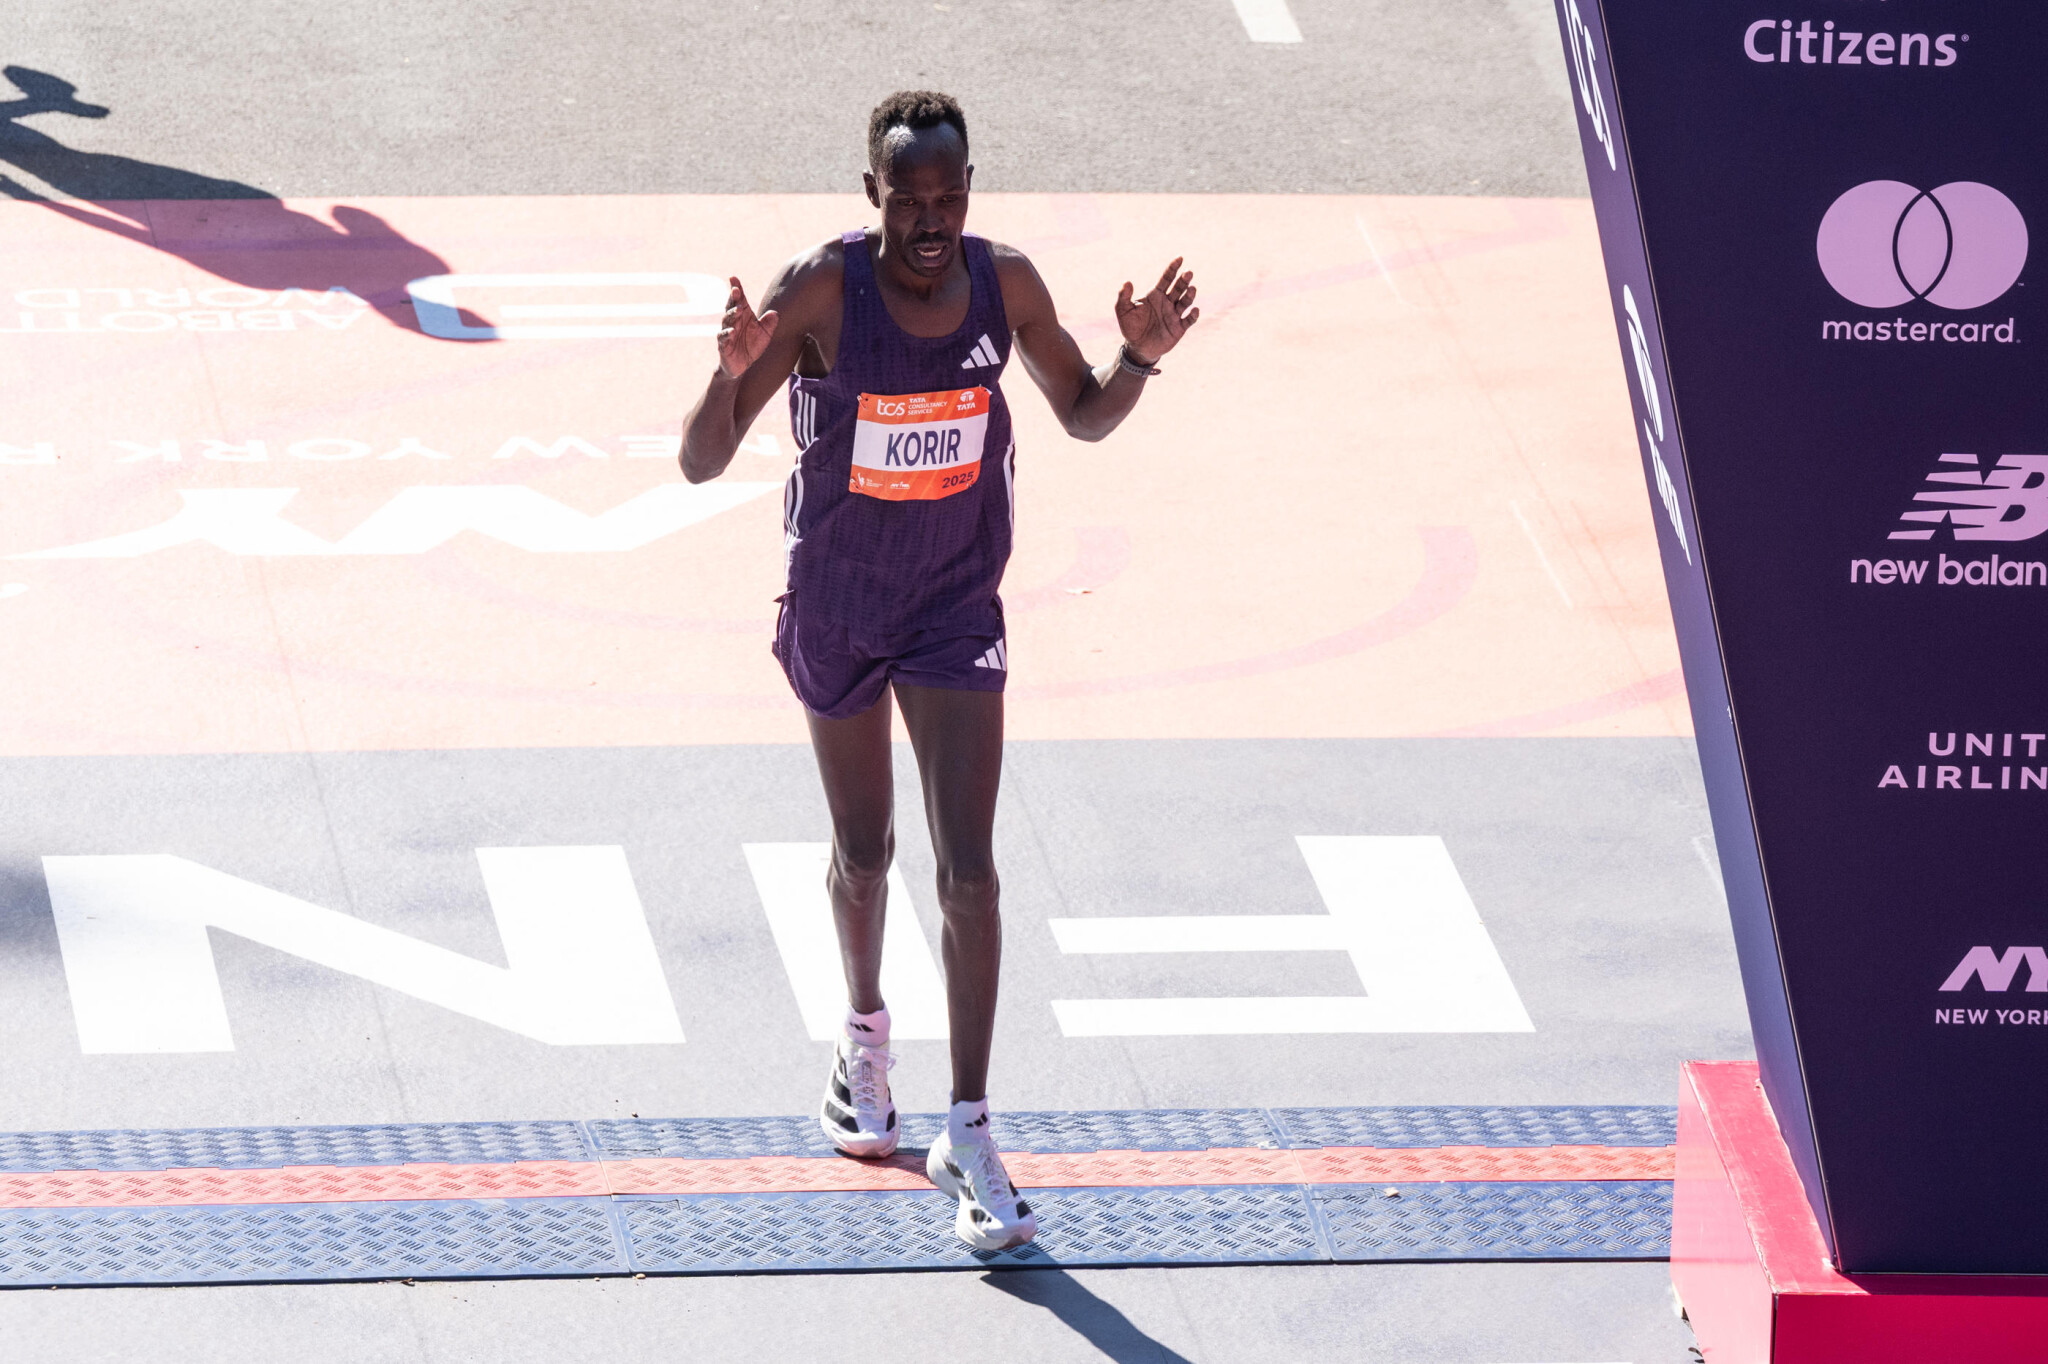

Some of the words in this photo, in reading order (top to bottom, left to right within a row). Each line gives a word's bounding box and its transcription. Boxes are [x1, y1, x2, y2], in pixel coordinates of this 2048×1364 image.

[1743, 19, 1957, 67] Citizens
[14, 285, 369, 309] WORLD
[0, 308, 369, 333] ABBOTT
[1822, 317, 2014, 343] mastercard
[877, 399, 905, 416] tcs
[908, 401, 947, 410] CONSULTANCY
[956, 402, 976, 411] TATA
[109, 437, 453, 463] YORK
[885, 428, 961, 466] KORIR
[942, 471, 974, 488] 2025
[1850, 559, 1930, 585] new
[1938, 553, 2048, 587] balan
[1928, 732, 2047, 757] UNIT
[1877, 765, 2048, 790] AIRLIN
[1935, 1008, 1989, 1025] NEW
